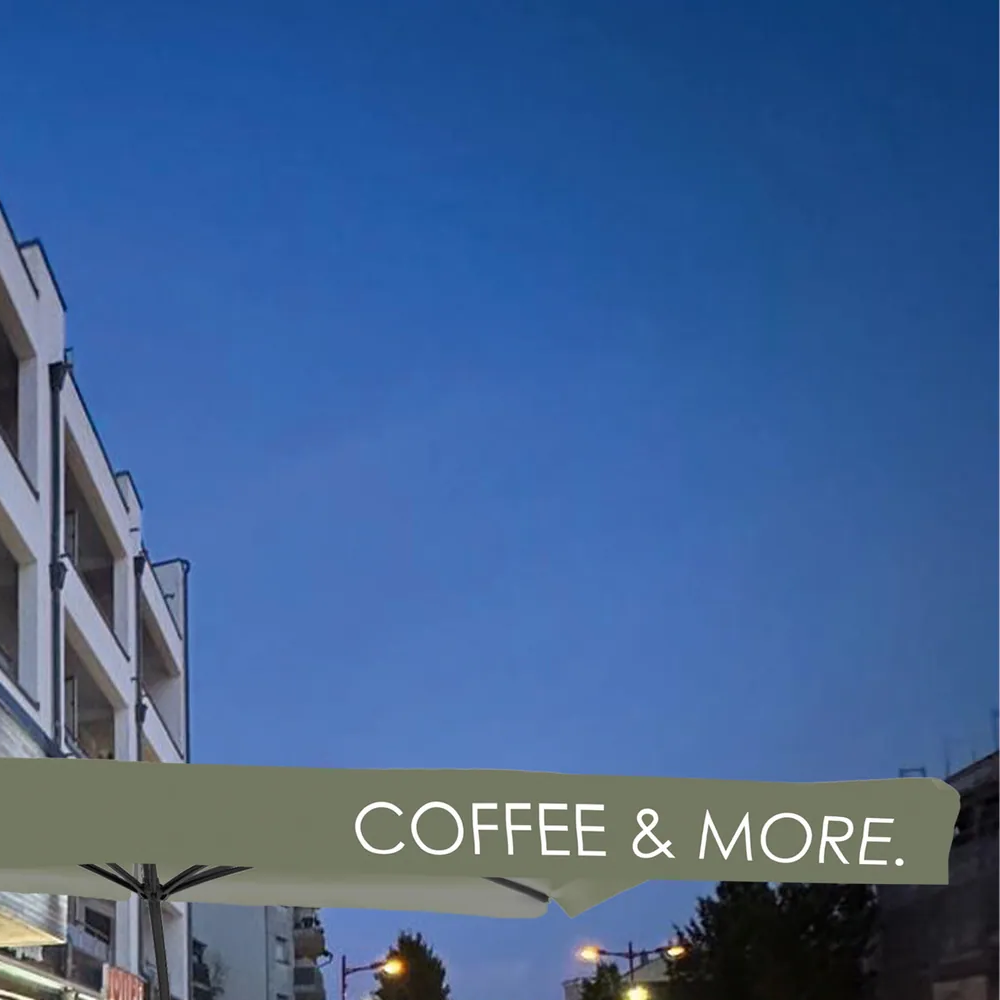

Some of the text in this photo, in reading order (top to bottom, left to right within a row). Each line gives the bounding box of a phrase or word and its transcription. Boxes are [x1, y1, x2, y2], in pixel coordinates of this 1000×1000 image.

[354, 801, 904, 867] COFFEE & MORE.
